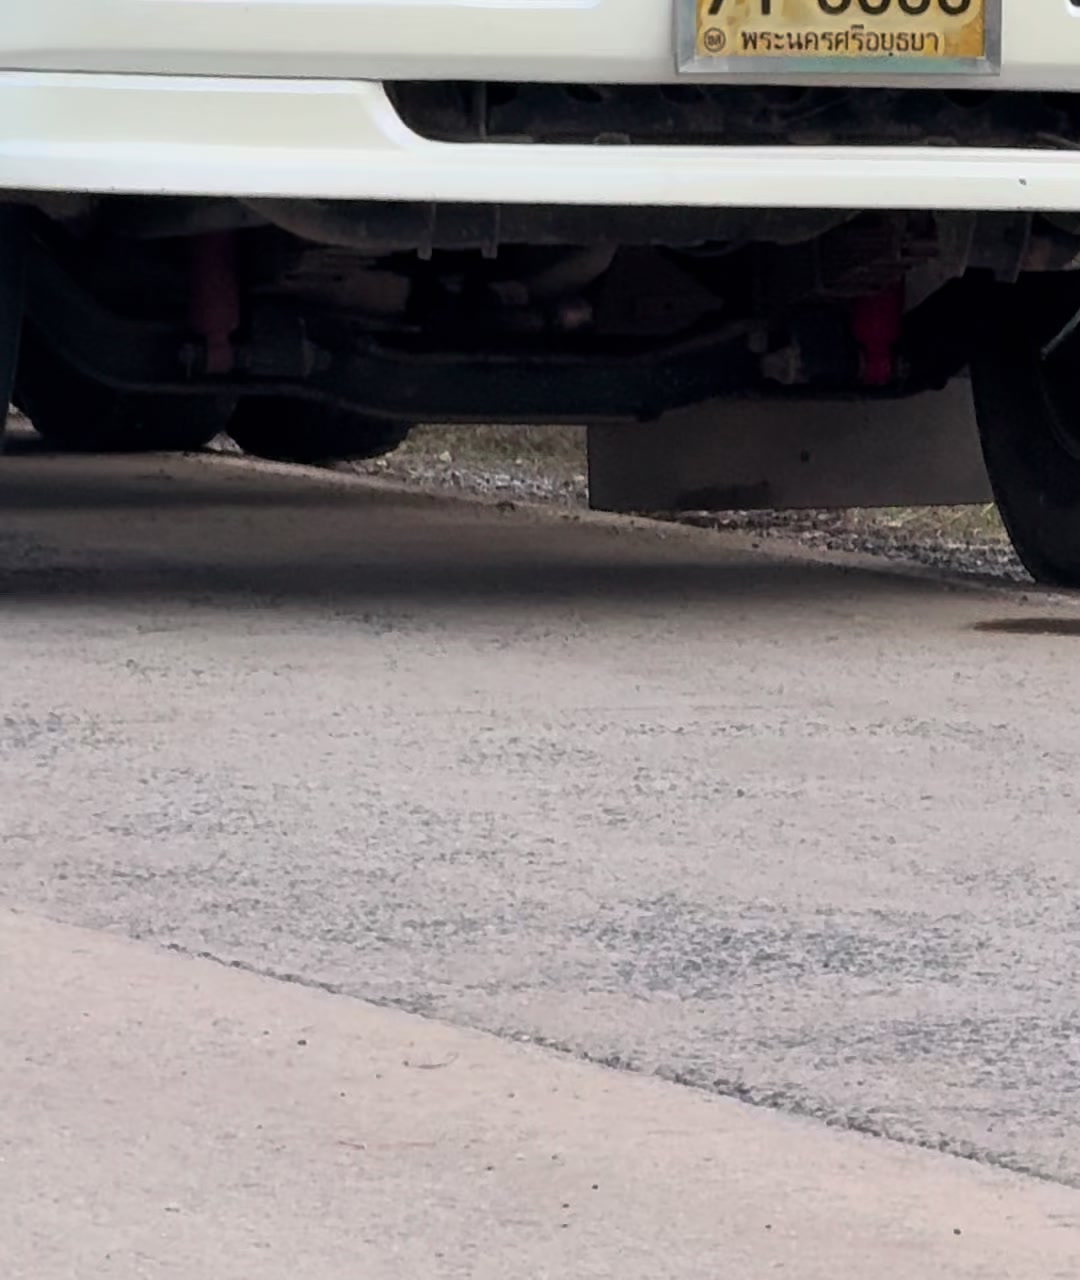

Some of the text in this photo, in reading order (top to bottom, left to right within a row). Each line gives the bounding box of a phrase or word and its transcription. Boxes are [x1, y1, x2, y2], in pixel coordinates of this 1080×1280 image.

[741, 24, 939, 56] พระนครศรีอยุธยา
